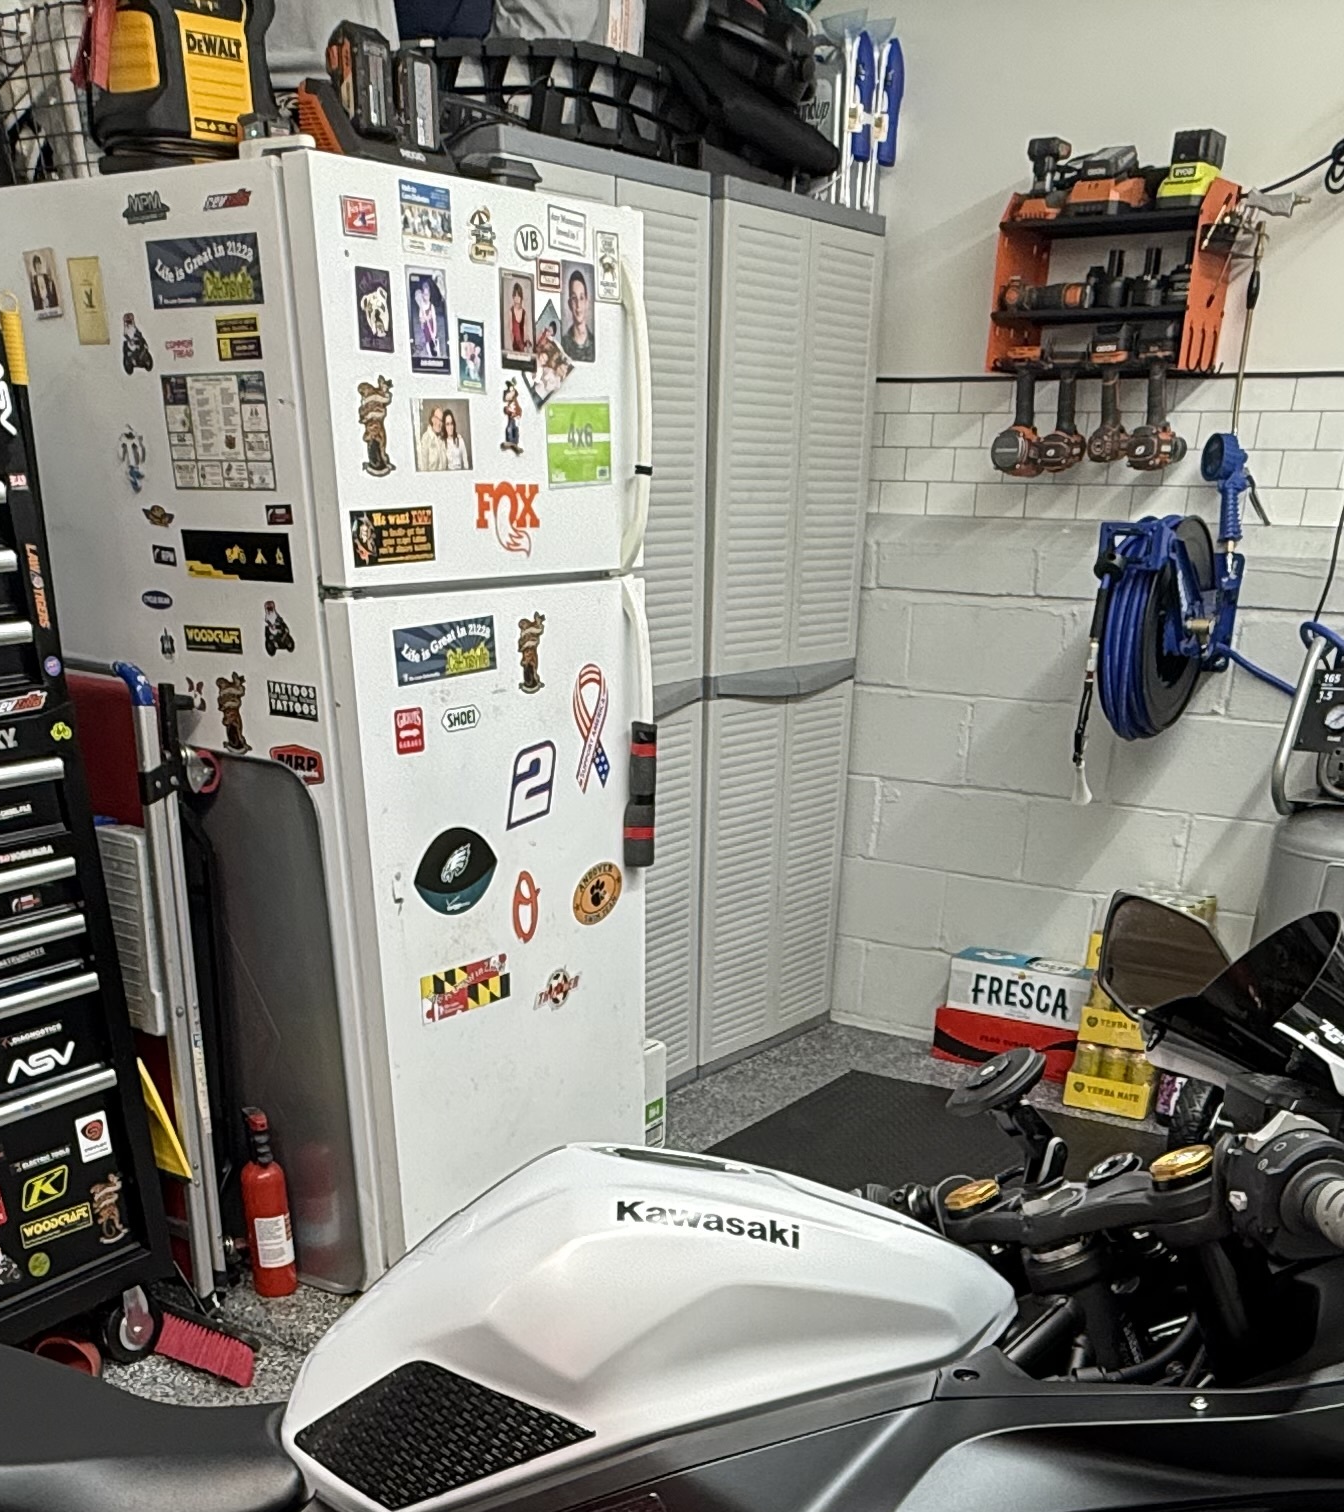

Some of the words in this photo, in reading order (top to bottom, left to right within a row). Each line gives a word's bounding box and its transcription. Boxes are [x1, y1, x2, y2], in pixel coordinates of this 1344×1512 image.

[519, 231, 539, 252] VB
[183, 246, 214, 275] Great
[567, 422, 594, 449] 4x6
[474, 480, 541, 529] FOX
[185, 627, 241, 645] WOODCRAFT
[401, 643, 422, 664] Life
[430, 629, 457, 654] Great
[268, 681, 316, 700] TATTOOS
[1323, 673, 1342, 684] 165
[270, 698, 317, 717] TATTOOS
[446, 708, 476, 728] SHOEI
[277, 753, 318, 771] MRP
[971, 973, 1070, 1021] FRESCA
[7, 1041, 76, 1084] ASV
[27, 1167, 66, 1209] K
[23, 1205, 89, 1238] WOODCRAFT
[615, 1199, 801, 1250] Kawasaki
